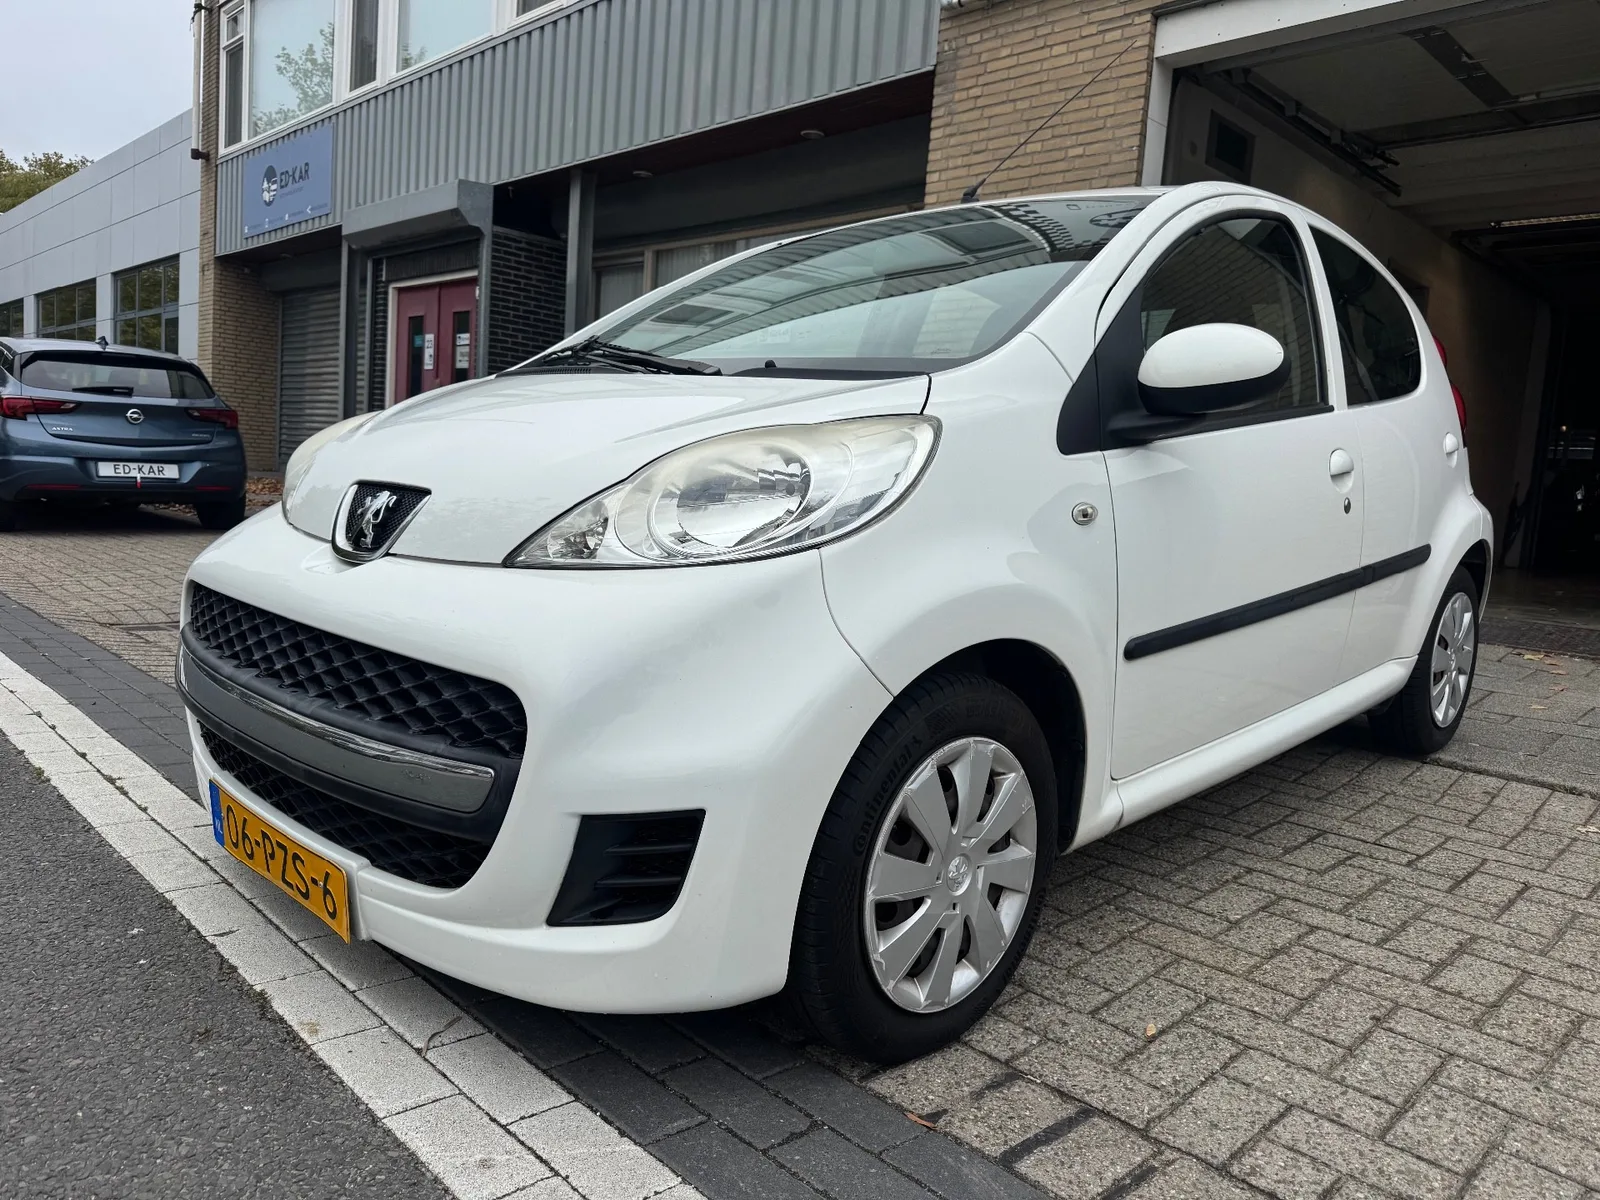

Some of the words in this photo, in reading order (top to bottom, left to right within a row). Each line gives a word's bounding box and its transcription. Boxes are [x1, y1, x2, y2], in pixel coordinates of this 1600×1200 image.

[279, 162, 310, 190] ED-KAR
[113, 463, 166, 476] ED-KAR
[226, 804, 338, 920] 06-PZS-6
